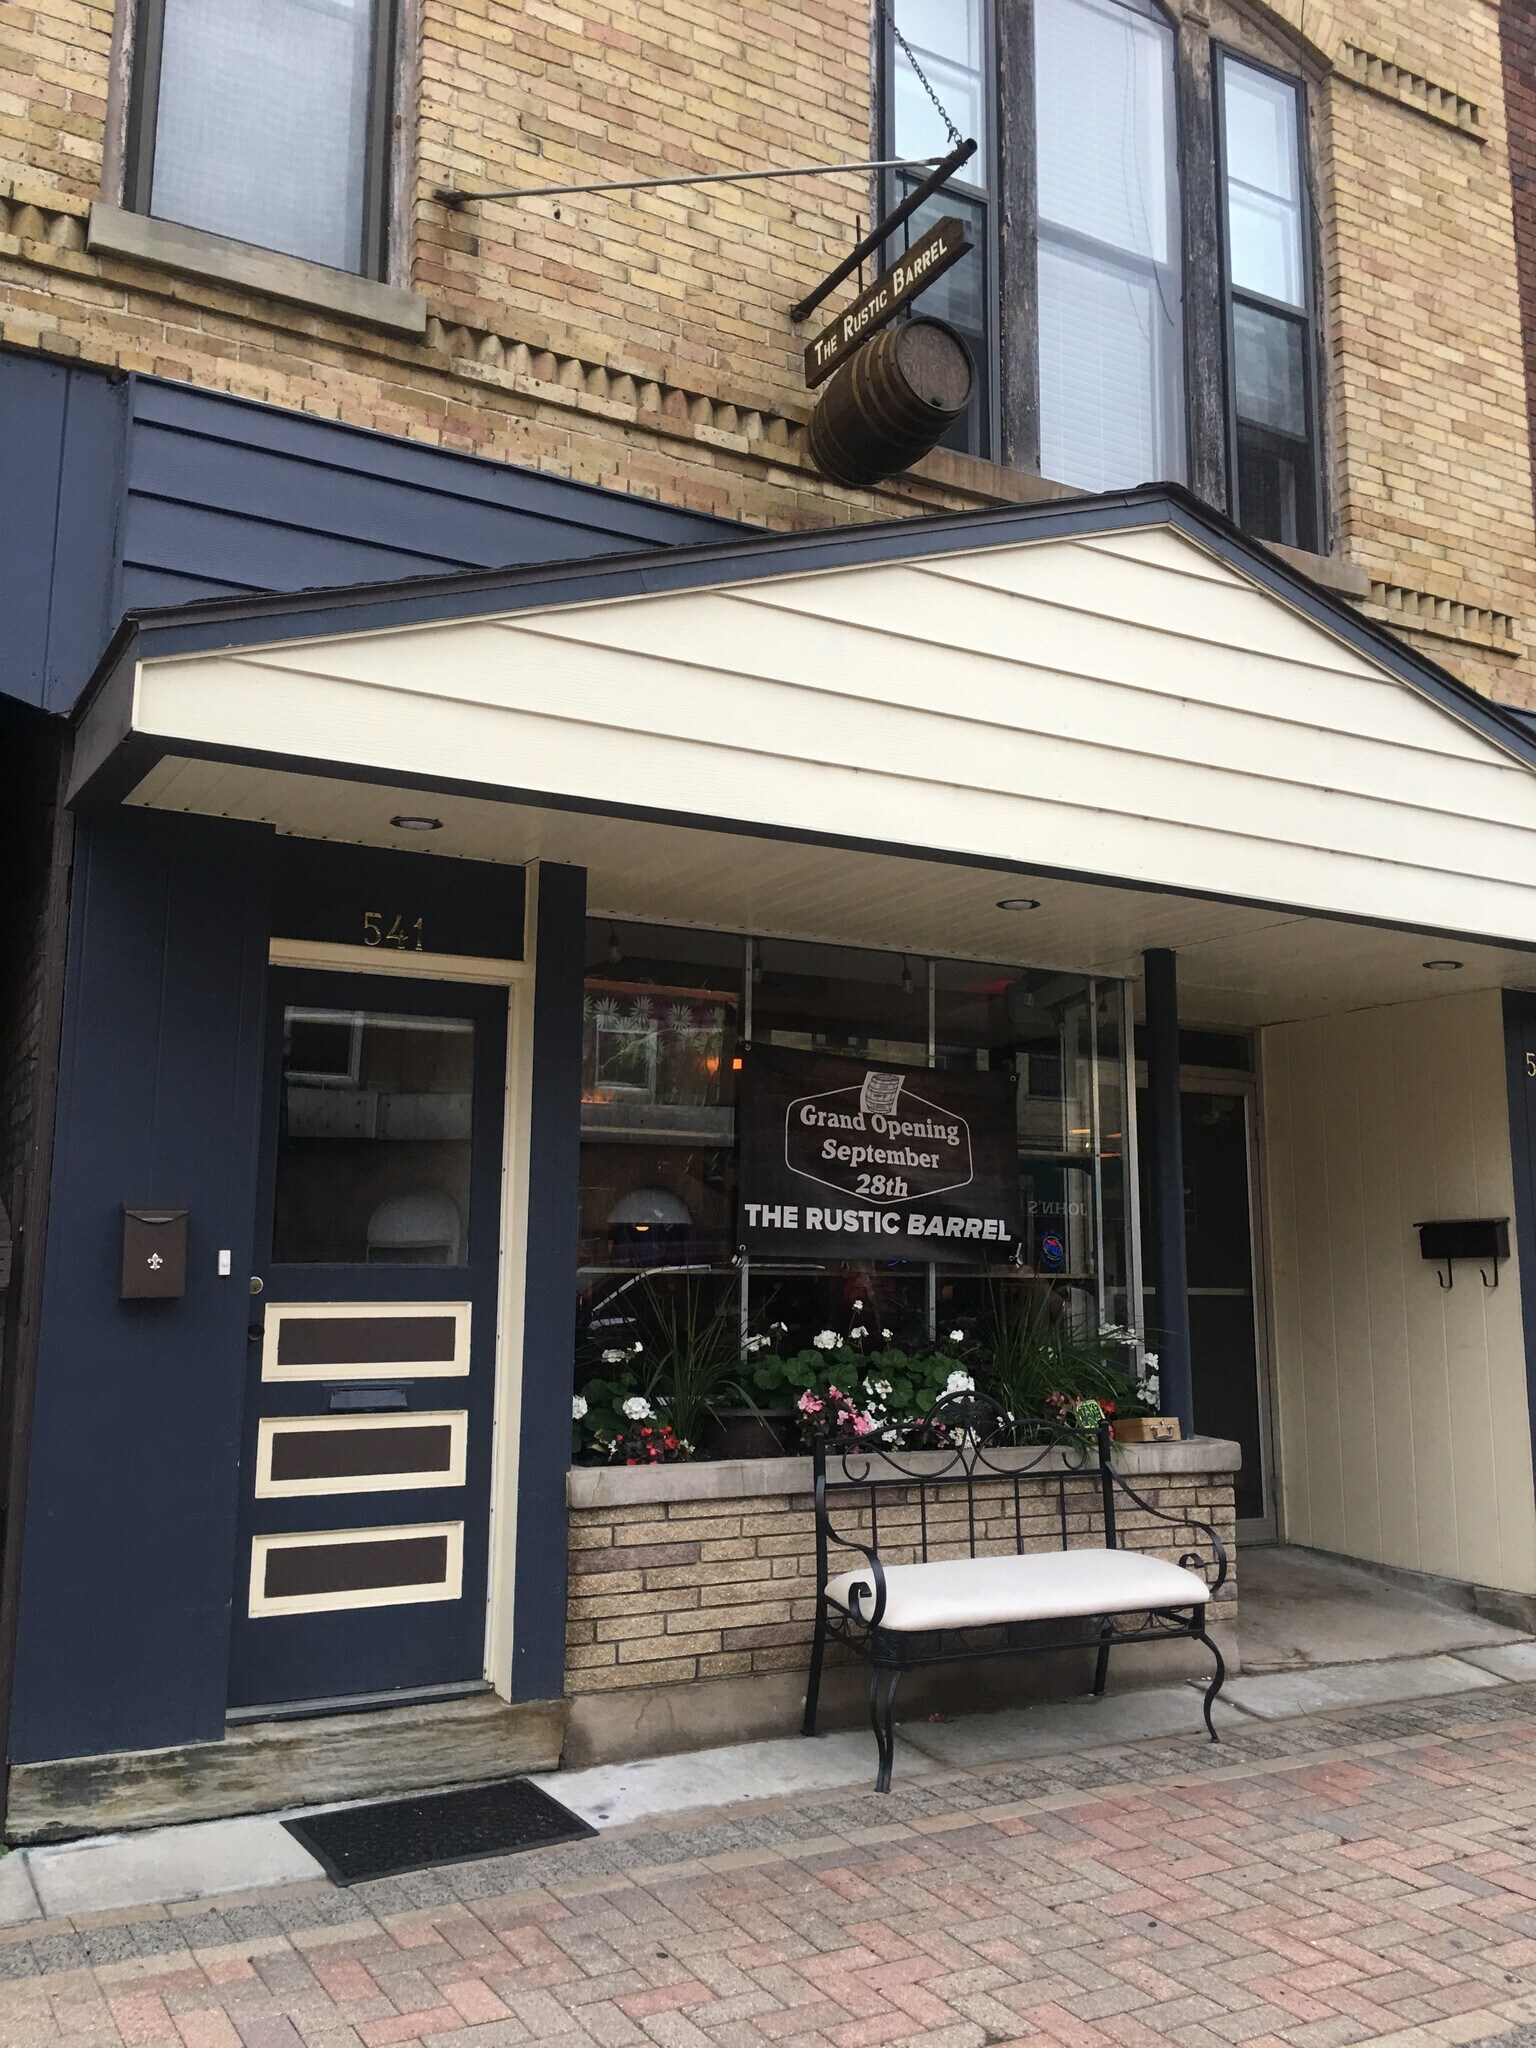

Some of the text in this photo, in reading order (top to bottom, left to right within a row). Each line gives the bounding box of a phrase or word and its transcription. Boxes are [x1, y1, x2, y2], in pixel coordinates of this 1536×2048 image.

[814, 238, 948, 366] THE RUSTIC BARREL
[364, 911, 424, 951] 541
[800, 1104, 960, 1146] Grand Opening
[821, 1138, 940, 1169] September
[855, 1173, 909, 1197] 28th
[744, 1203, 1011, 1241] THE RUSTIC BARREL
